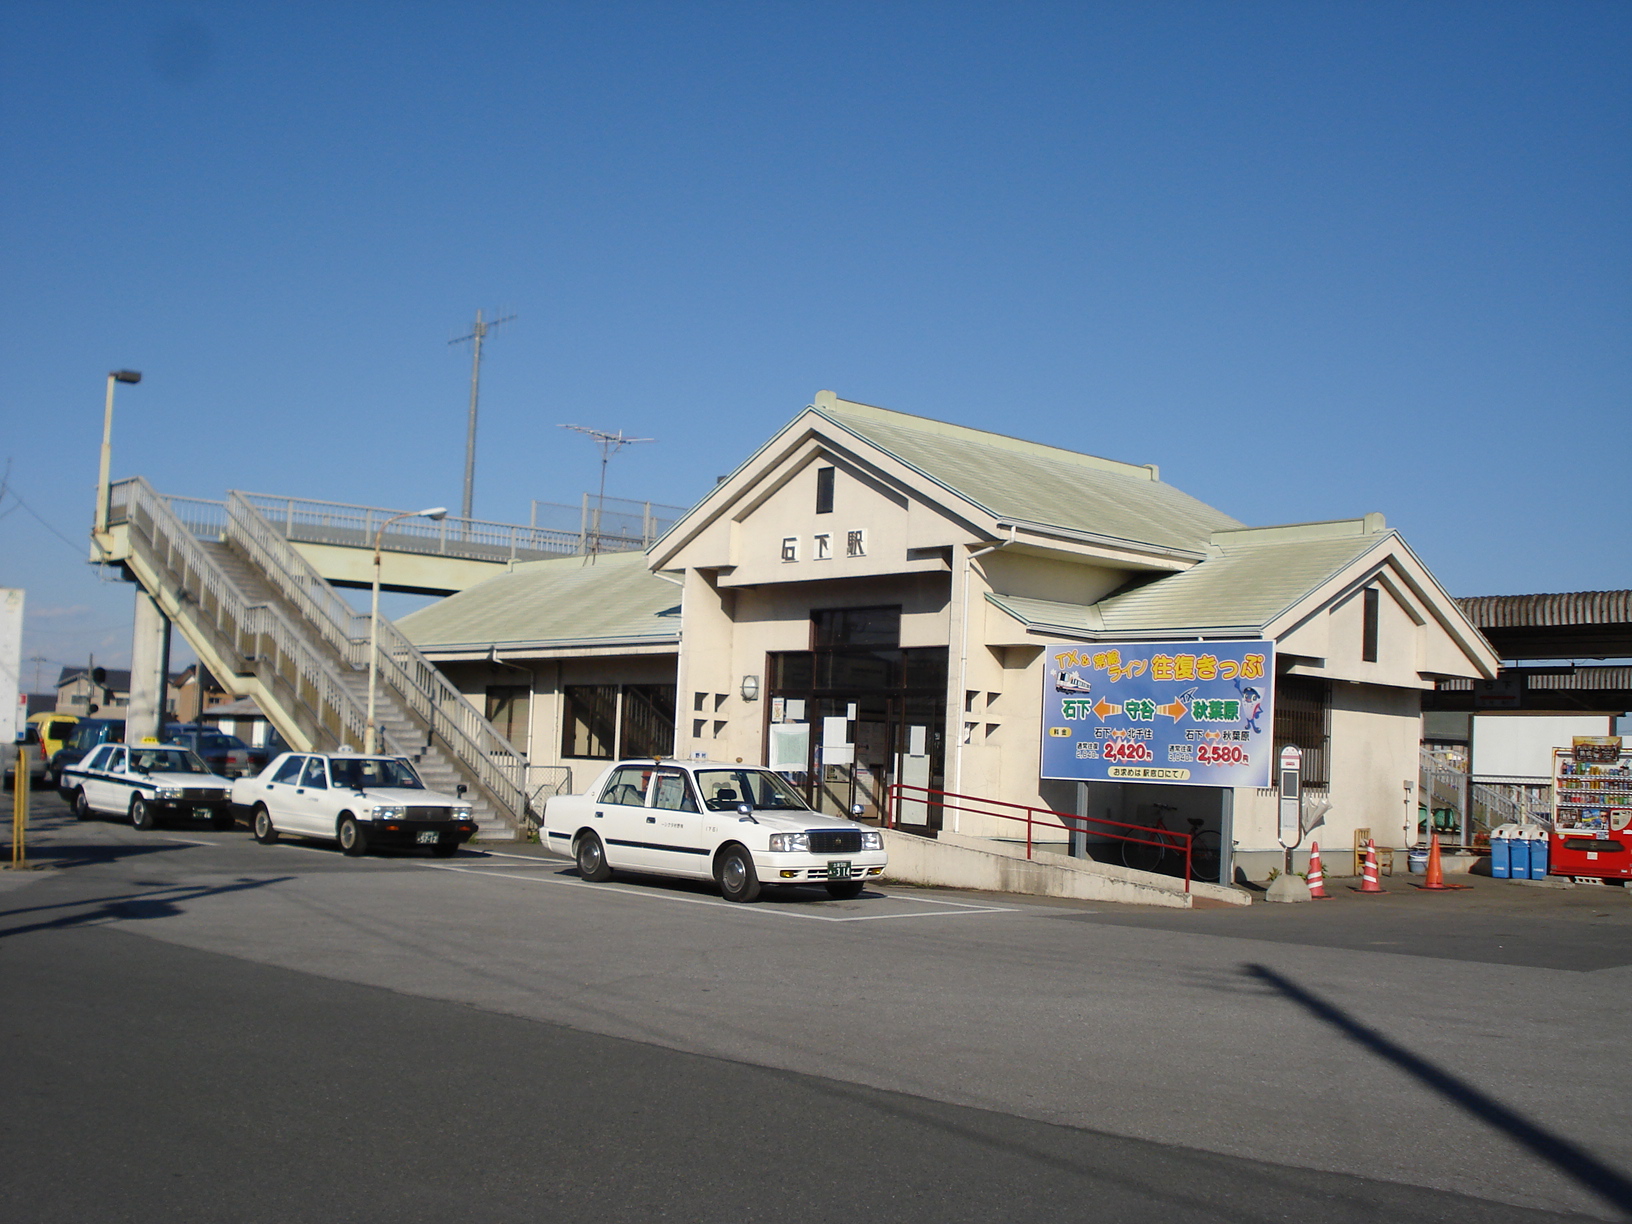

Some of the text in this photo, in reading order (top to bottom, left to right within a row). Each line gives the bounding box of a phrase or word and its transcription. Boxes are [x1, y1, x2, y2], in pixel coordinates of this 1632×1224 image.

[780, 529, 865, 562] 石下駅
[1152, 653, 1265, 681] 往復きっぷ
[1062, 699, 1092, 721] 石下
[1124, 698, 1156, 721] 守谷
[1191, 699, 1240, 721] 秋葉原
[1053, 728, 1068, 737] 料金
[1095, 727, 1153, 739] 石下 北千住
[1186, 729, 1250, 741] 石下 秋葉原
[1104, 743, 1153, 762] 2,420円
[1198, 745, 1249, 765] 2,580円
